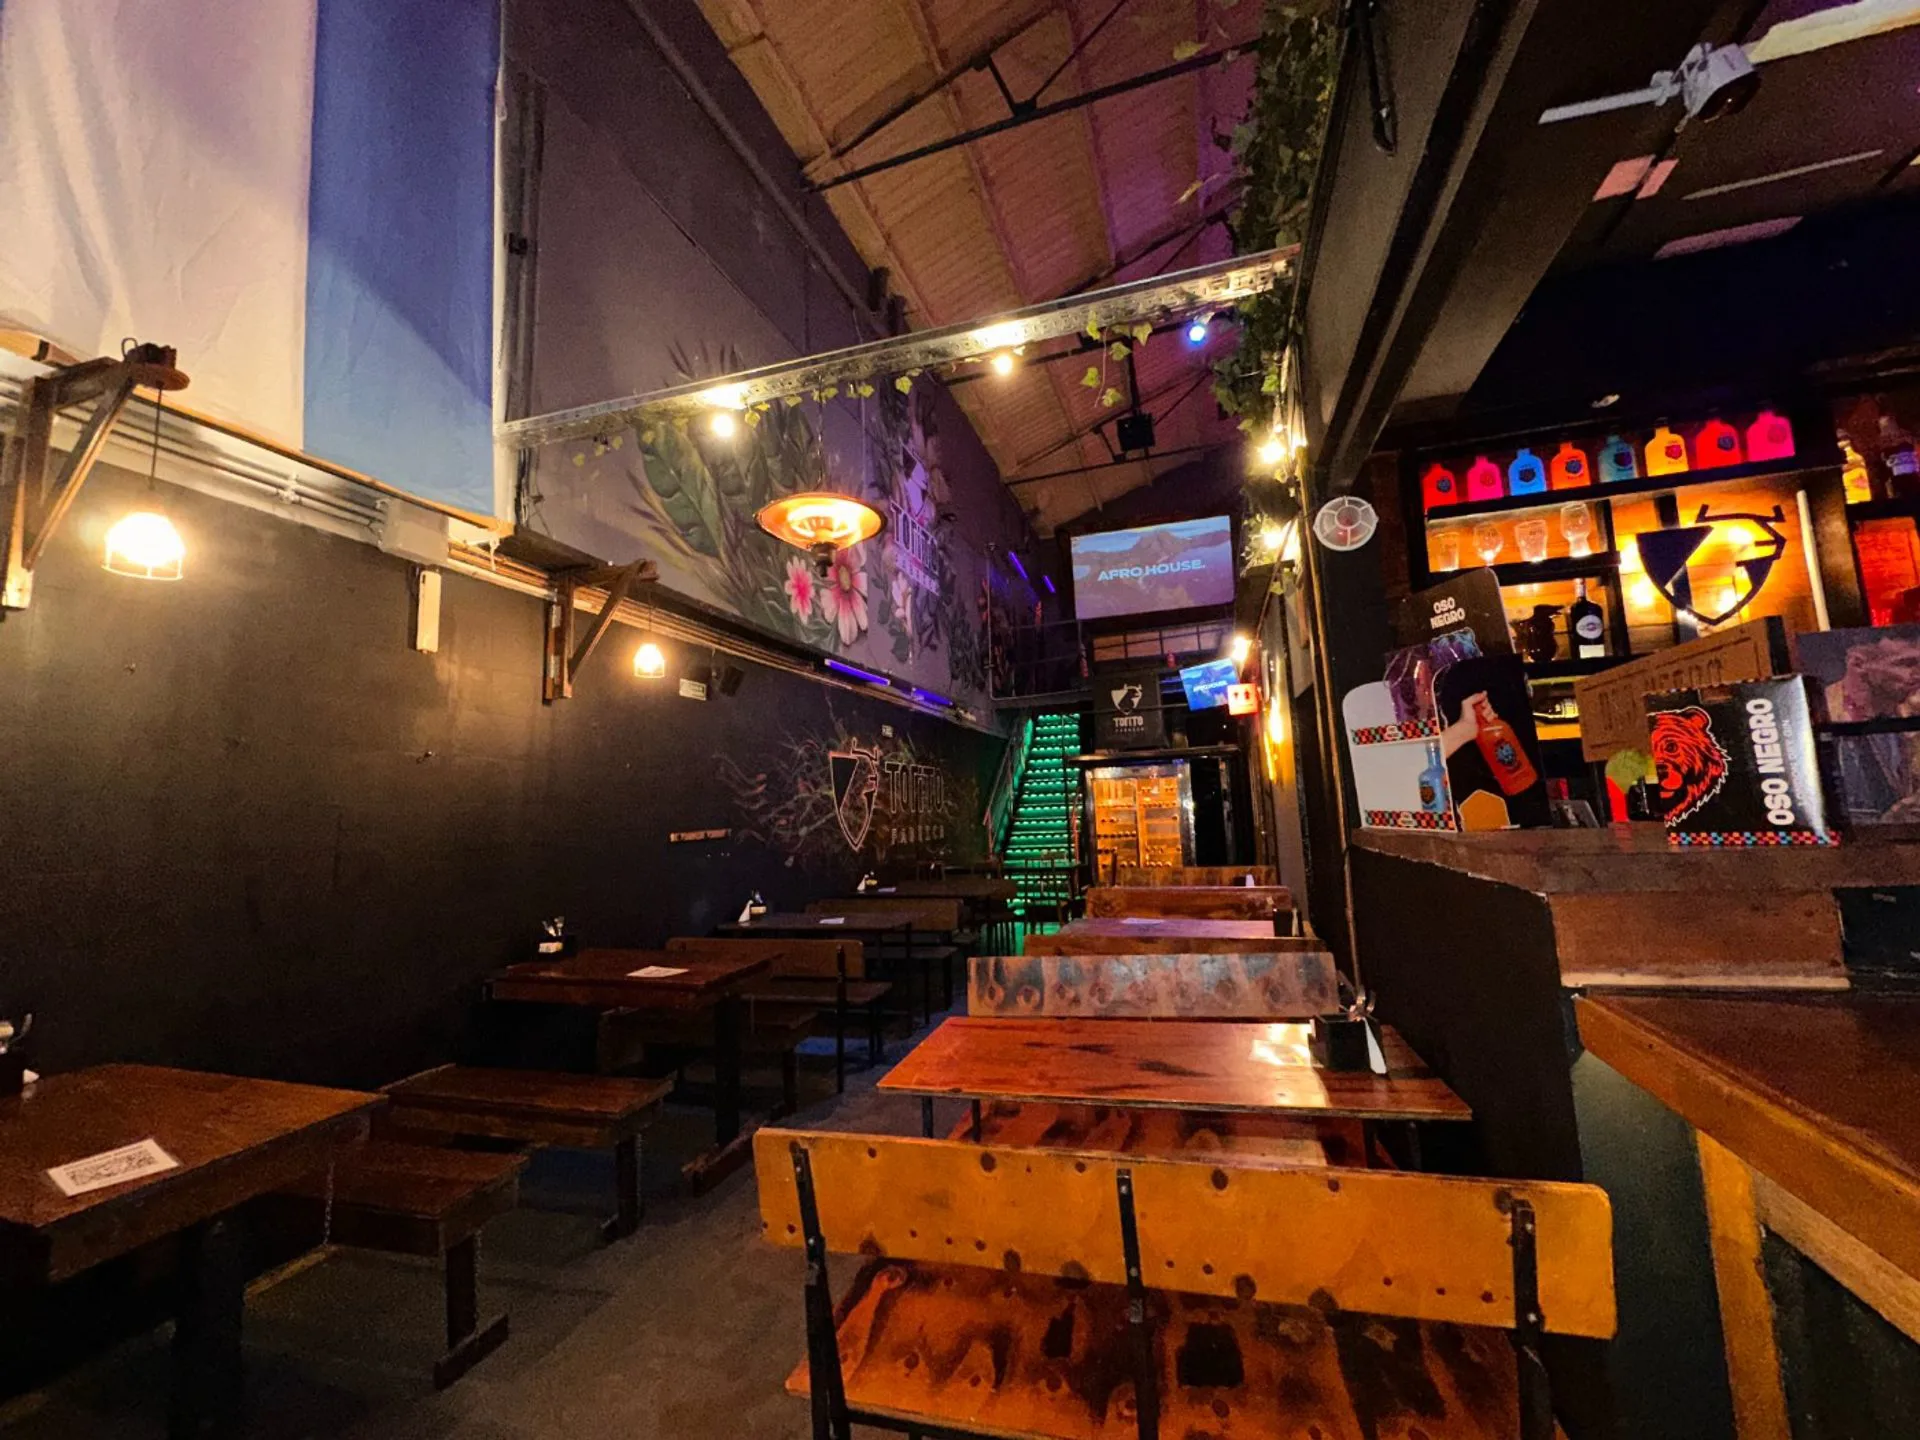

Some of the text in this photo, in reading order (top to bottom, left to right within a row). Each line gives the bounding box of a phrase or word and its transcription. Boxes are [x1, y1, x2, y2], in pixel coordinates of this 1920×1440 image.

[1097, 566, 1144, 581] AFRO
[1433, 597, 1455, 614] OSO
[1430, 608, 1466, 630] NEGRO
[1745, 698, 1796, 826] OSO NEGRO
